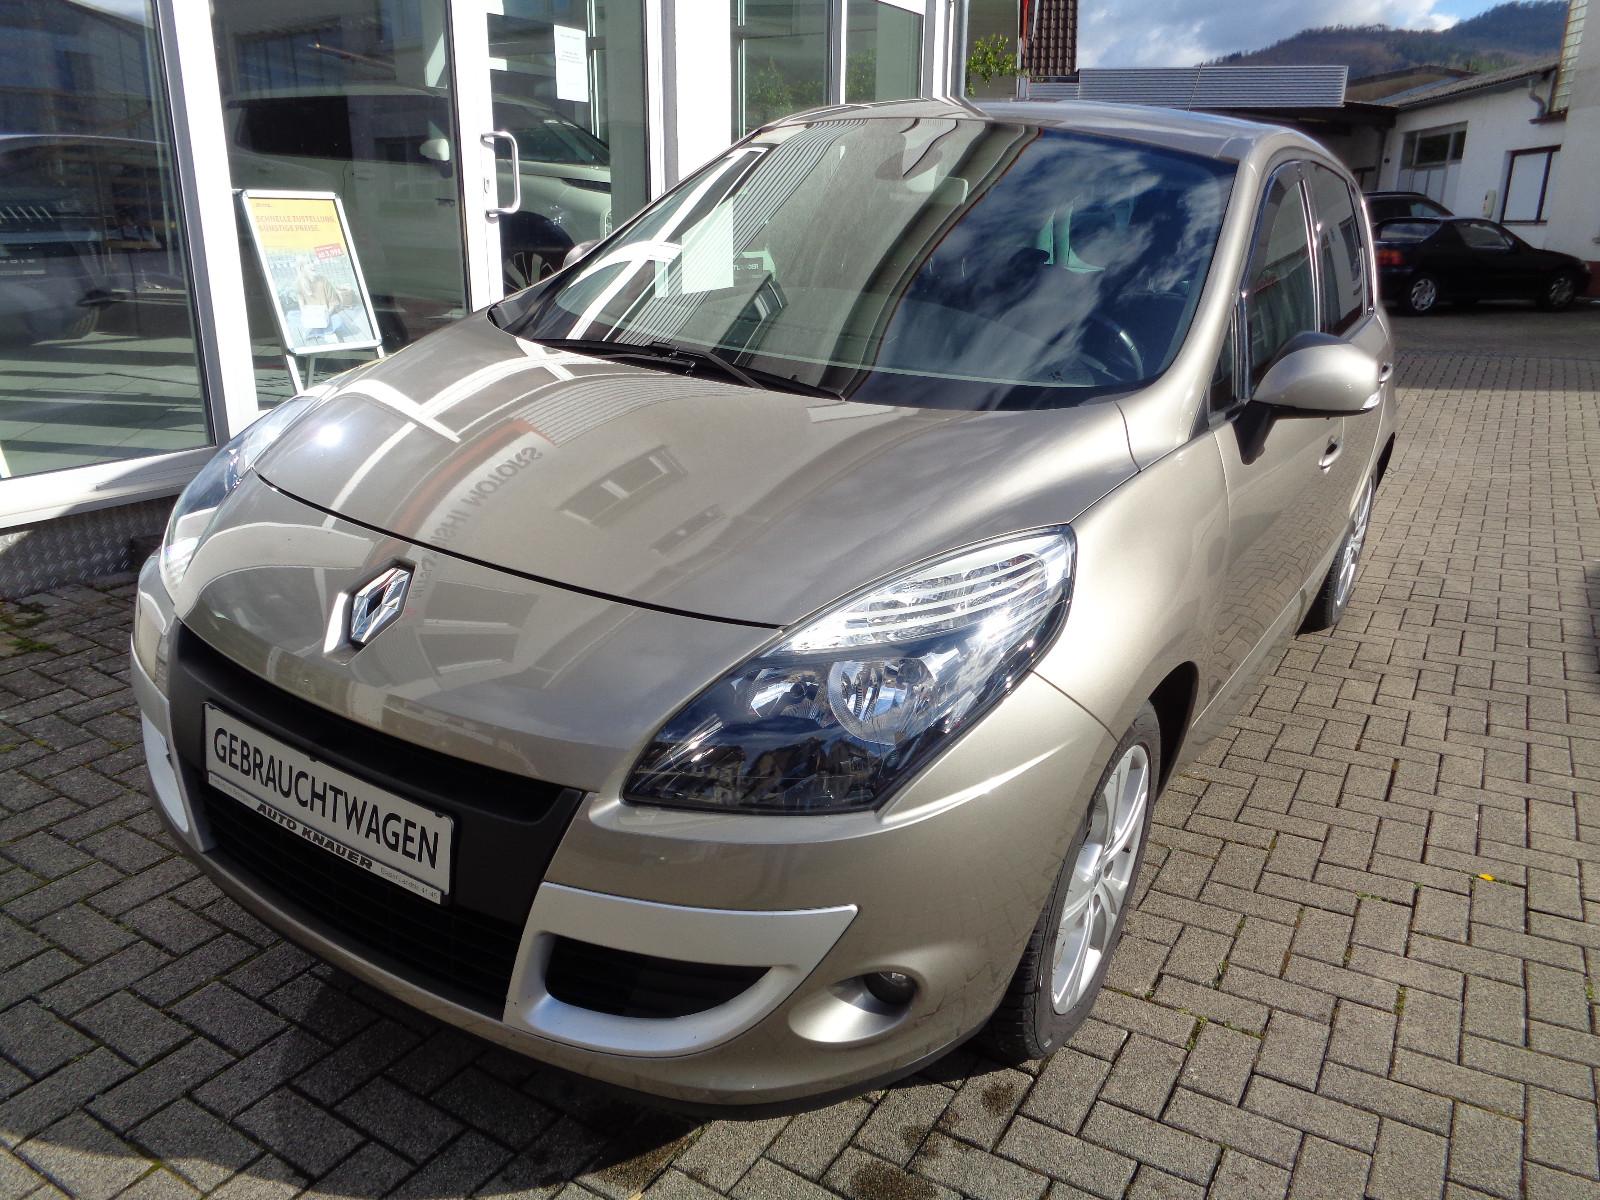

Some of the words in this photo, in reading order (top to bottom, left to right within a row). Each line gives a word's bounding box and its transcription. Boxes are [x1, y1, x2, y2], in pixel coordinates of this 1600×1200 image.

[213, 727, 439, 870] GEBRAUCHTWAGEN
[256, 803, 298, 832] AUTO
[301, 824, 373, 870] KNAUER
